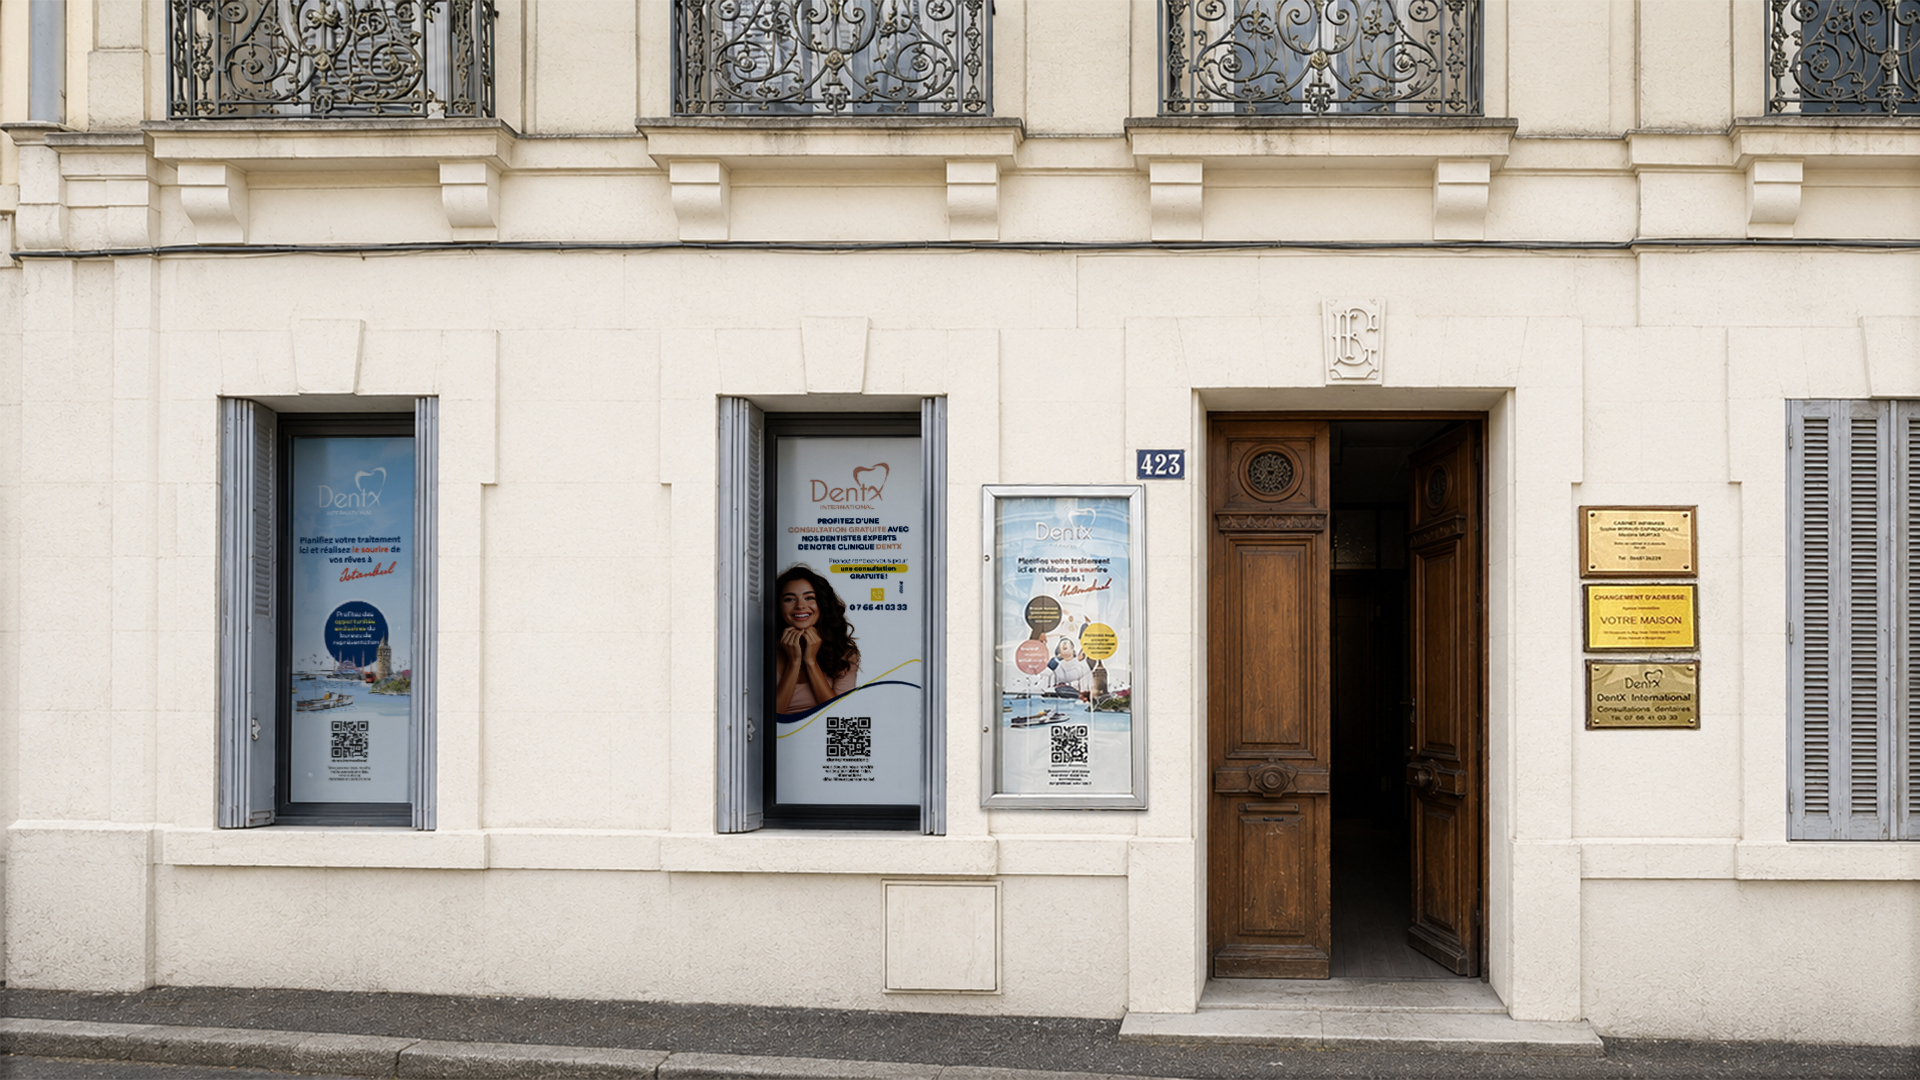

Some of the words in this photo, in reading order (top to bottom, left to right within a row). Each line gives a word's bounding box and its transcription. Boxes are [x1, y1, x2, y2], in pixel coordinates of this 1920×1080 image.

[1140, 453, 1180, 475] 423
[817, 517, 855, 525] PROFITEZ
[855, 517, 880, 525] D'UNE
[788, 526, 847, 534] CONSULTATION
[887, 525, 910, 533] AVEC
[299, 536, 334, 544] Planifiez
[334, 536, 357, 544] votre
[357, 535, 401, 544] traitement
[862, 534, 897, 542] EXPERTS
[299, 546, 309, 554] ici
[310, 546, 319, 554] et
[320, 546, 351, 554] réalisez
[361, 545, 389, 553] sourire
[390, 545, 401, 553] de
[837, 543, 875, 551] CLINIQUE
[328, 556, 343, 564] vos
[344, 555, 366, 564] rêves
[367, 555, 373, 563] à
[862, 603, 874, 611] 66
[874, 603, 884, 611] 41
[884, 603, 896, 611] 03
[896, 603, 908, 611] 33
[1600, 615, 1637, 625] VOTRE
[1640, 615, 1682, 625] MAISON
[1596, 693, 1627, 702] DentX
[1631, 693, 1691, 702] International
[1596, 705, 1651, 713] Consultations
[1654, 705, 1691, 713] dentaires
